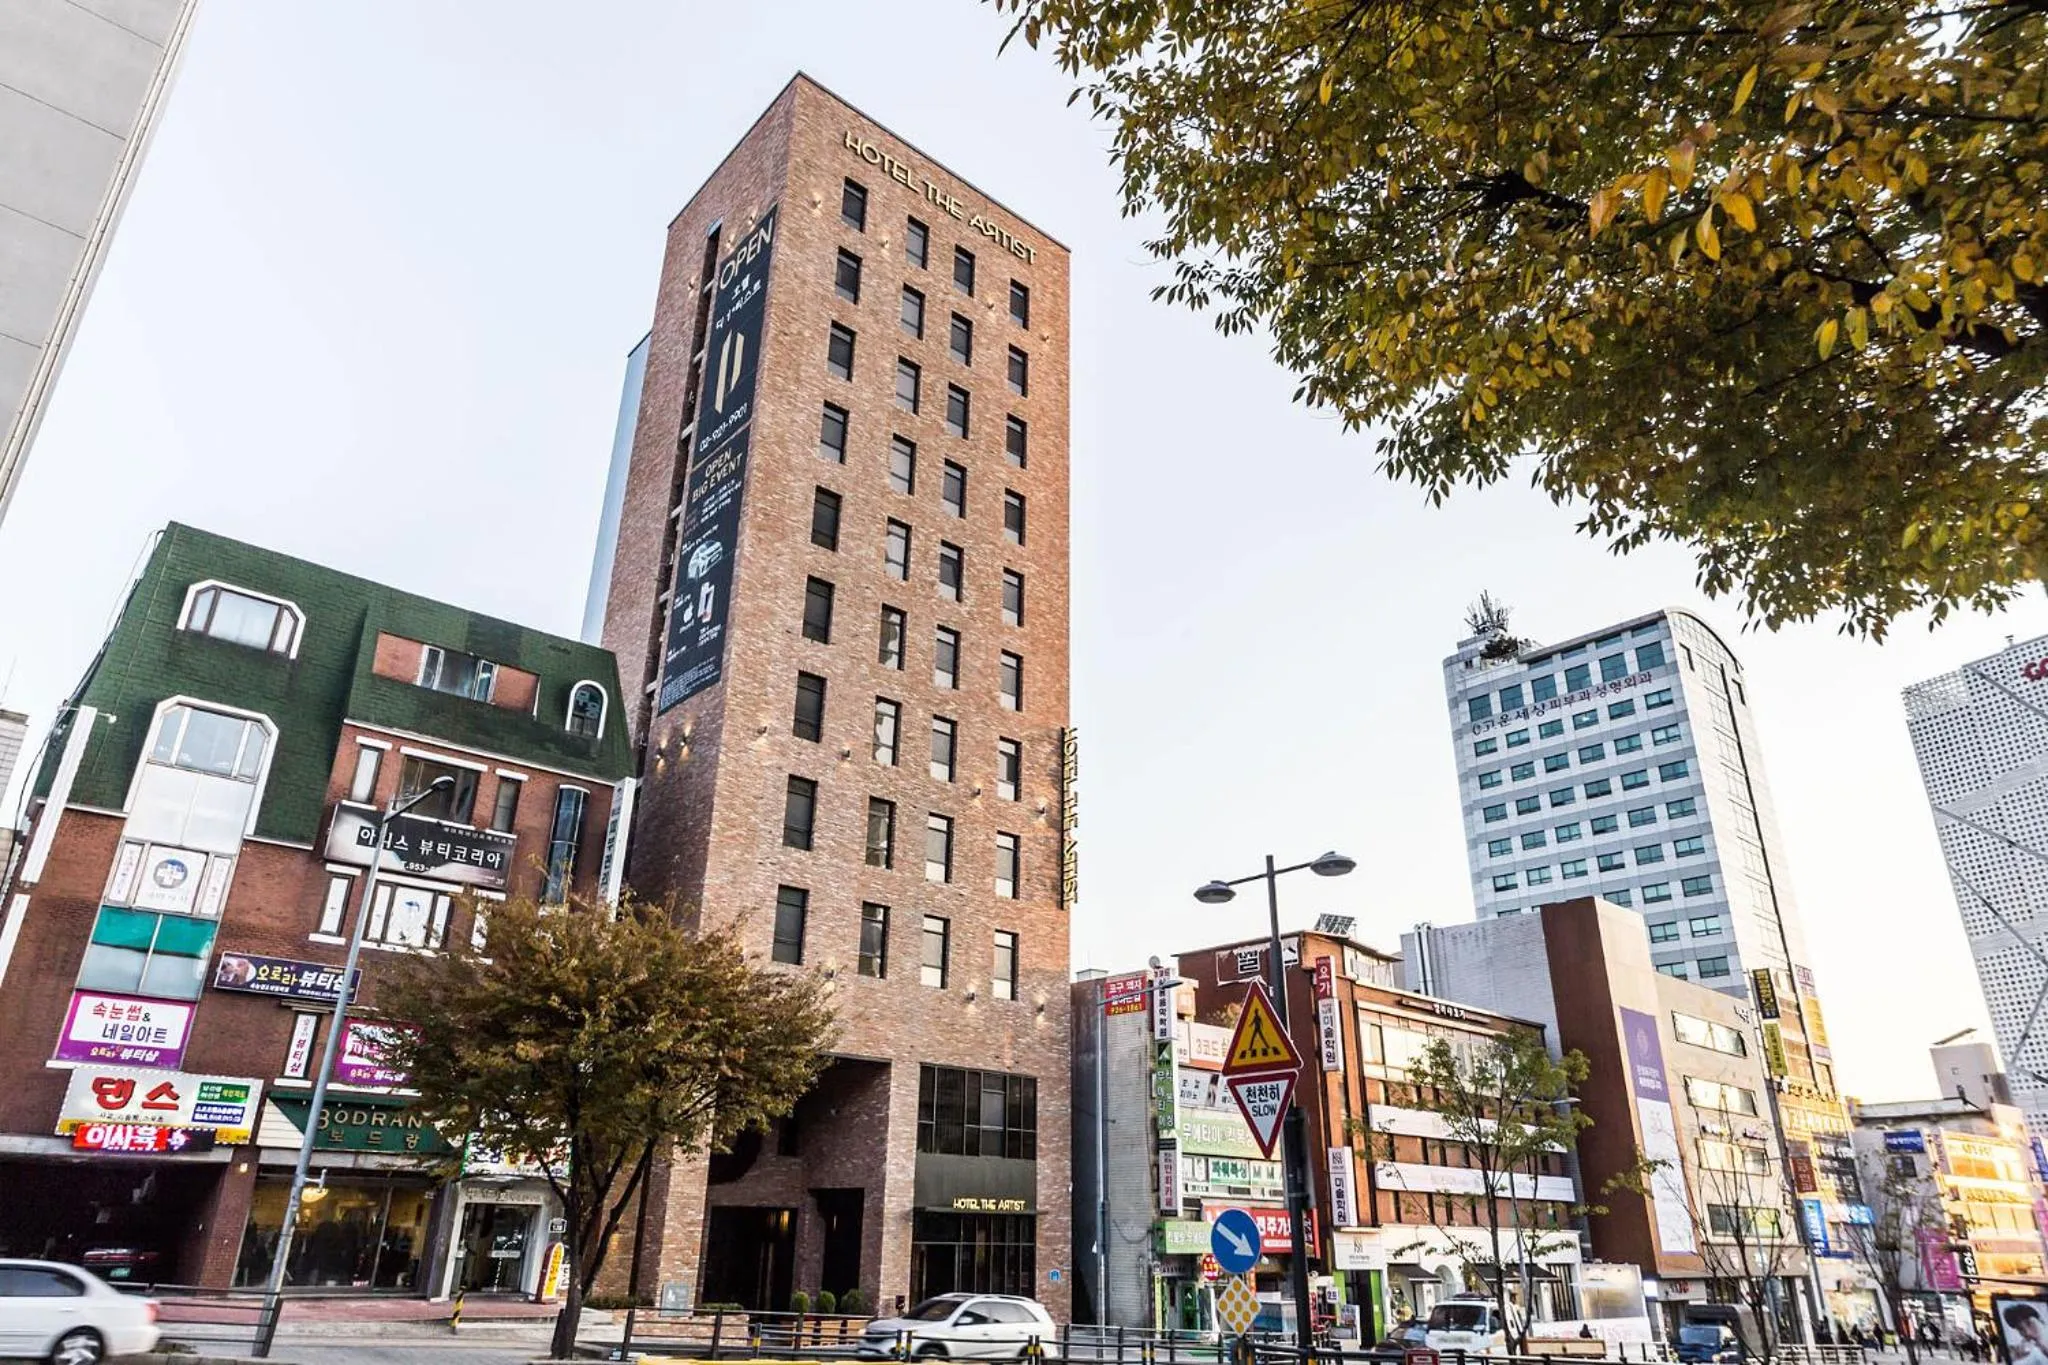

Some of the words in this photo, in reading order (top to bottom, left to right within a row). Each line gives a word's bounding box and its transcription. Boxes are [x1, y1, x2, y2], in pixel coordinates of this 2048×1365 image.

[844, 130, 920, 193] HOTEL
[922, 179, 964, 221] THE
[969, 214, 1037, 265] ARTIST
[719, 217, 774, 290] OPEN
[692, 480, 709, 503] BIG
[709, 452, 743, 492] EVENT
[705, 447, 732, 478] OPEN
[1063, 726, 1078, 792] HOTEL
[1063, 792, 1078, 832] THE
[419, 839, 502, 869] 뷰티코리아
[256, 964, 298, 987] 오로라
[102, 1023, 168, 1044] 네일아트
[119, 1047, 161, 1062] 뷰티샵
[92, 1077, 181, 1111] 댄스
[1246, 1083, 1280, 1104] 천천히
[317, 1107, 422, 1129] BODRAN
[1251, 1104, 1278, 1118] SLOW
[953, 1198, 980, 1210] HOTEL
[981, 1198, 996, 1210] THE
[998, 1199, 1025, 1211] ARTIST
